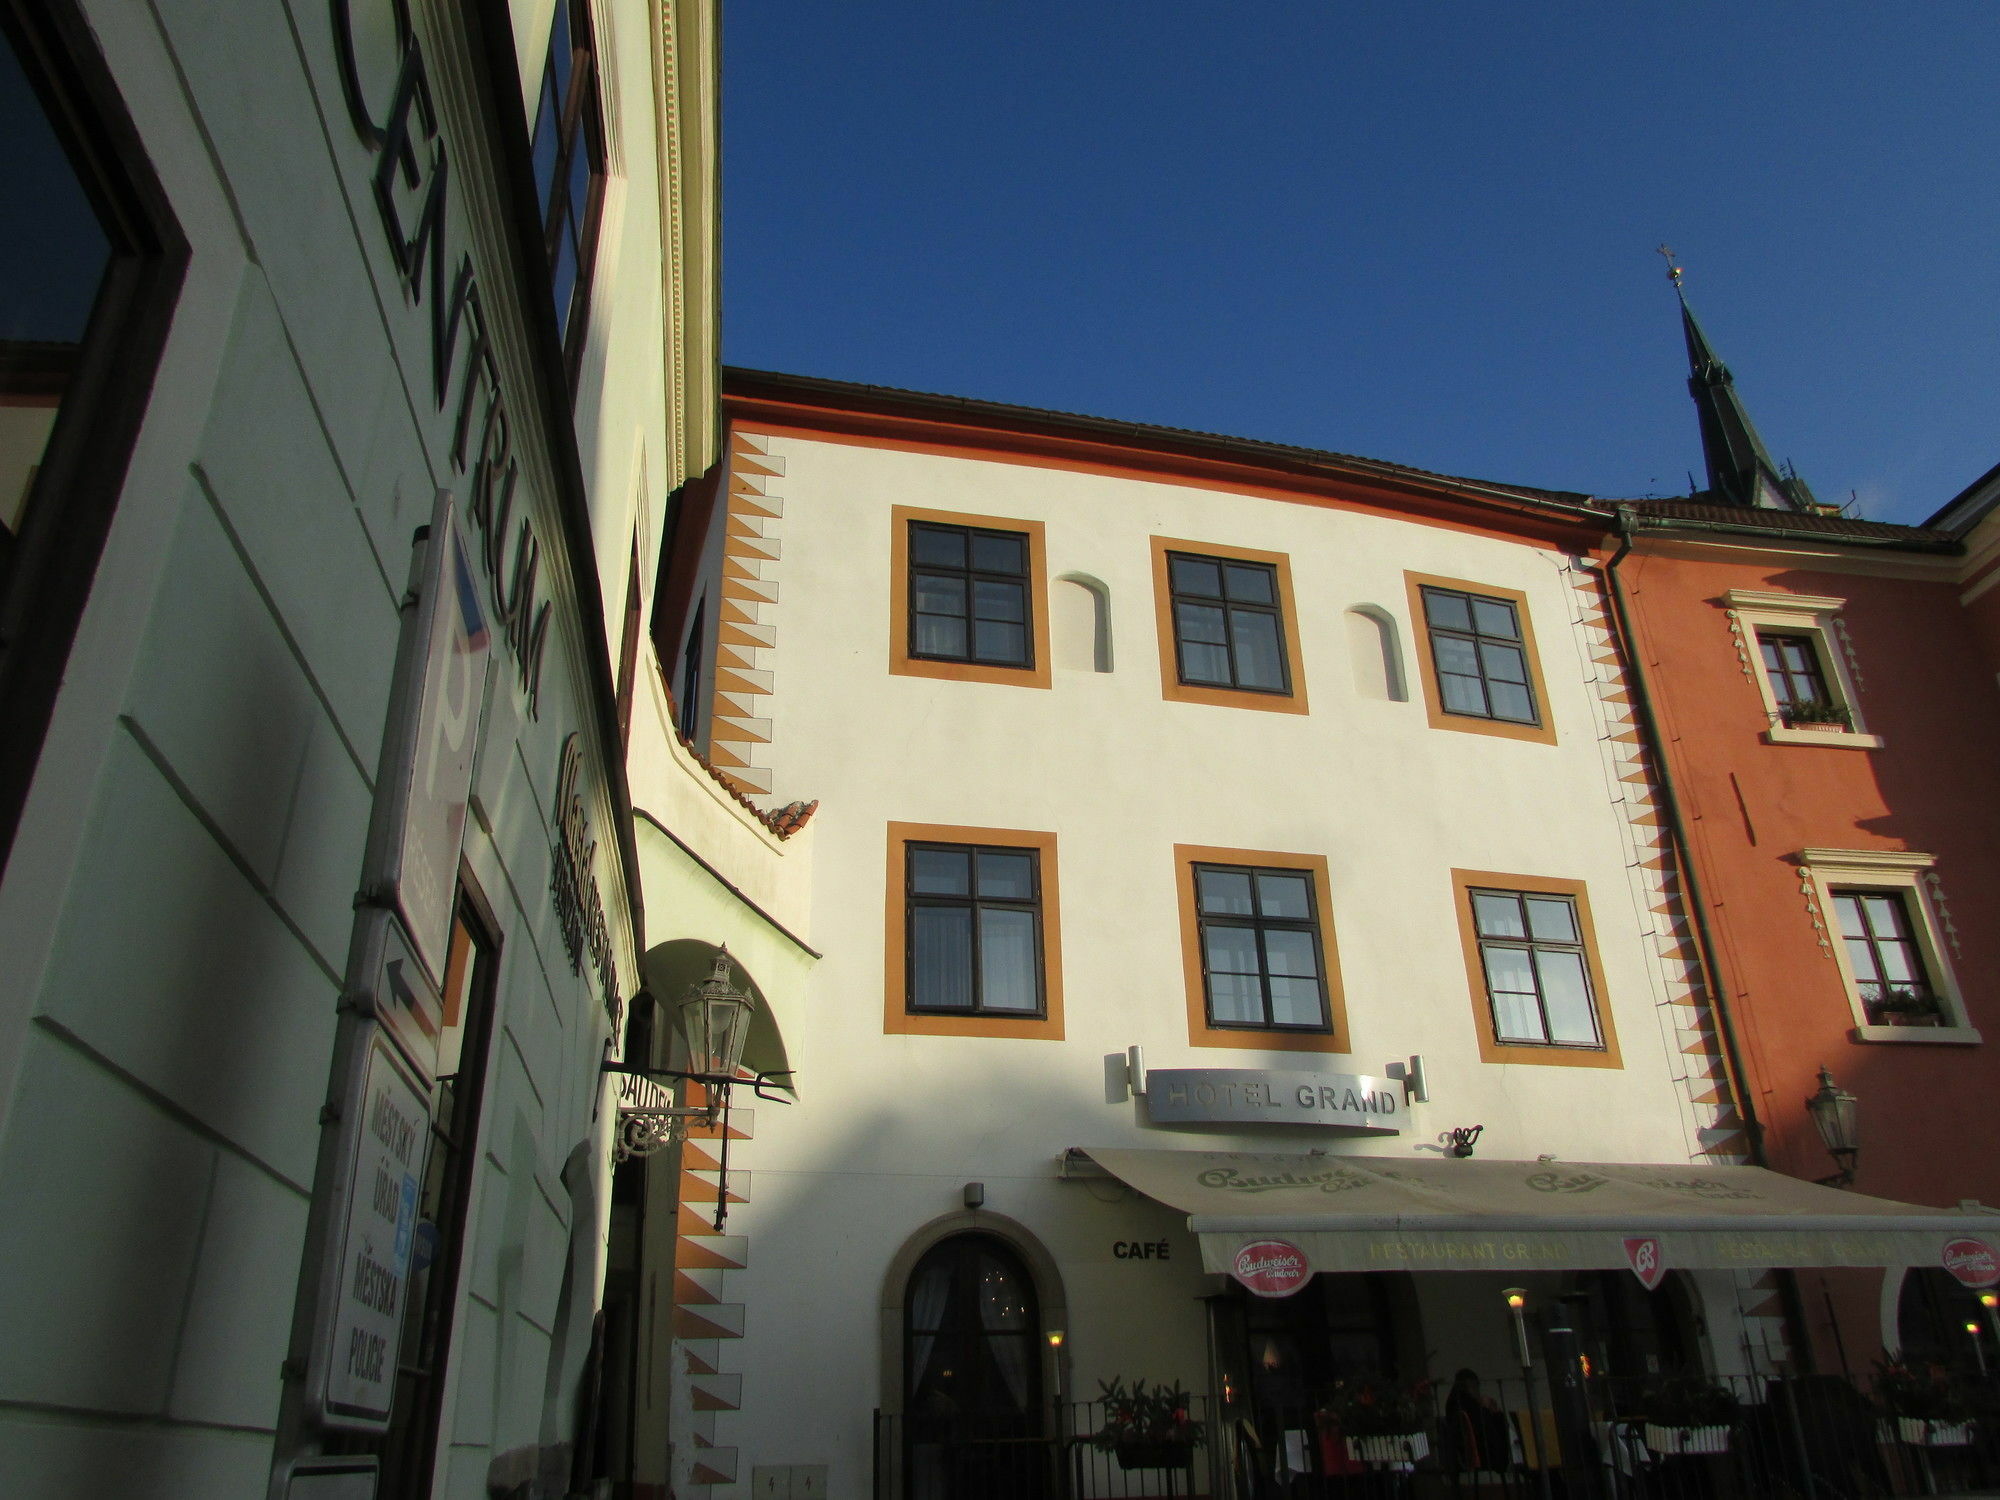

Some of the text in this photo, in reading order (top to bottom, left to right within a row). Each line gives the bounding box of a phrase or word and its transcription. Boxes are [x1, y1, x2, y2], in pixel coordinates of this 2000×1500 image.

[425, 590, 471, 801] P
[1168, 1082, 1396, 1115] HOTEL GRAND
[371, 1084, 421, 1169] MĚSTSKÝ
[373, 1155, 399, 1226] ÚŘAD
[1113, 1238, 1170, 1261] CAFÉ
[1238, 1254, 1302, 1277] Budweiser
[1369, 1241, 1496, 1261] RESTAURANT
[348, 1325, 387, 1384] POLICIE
